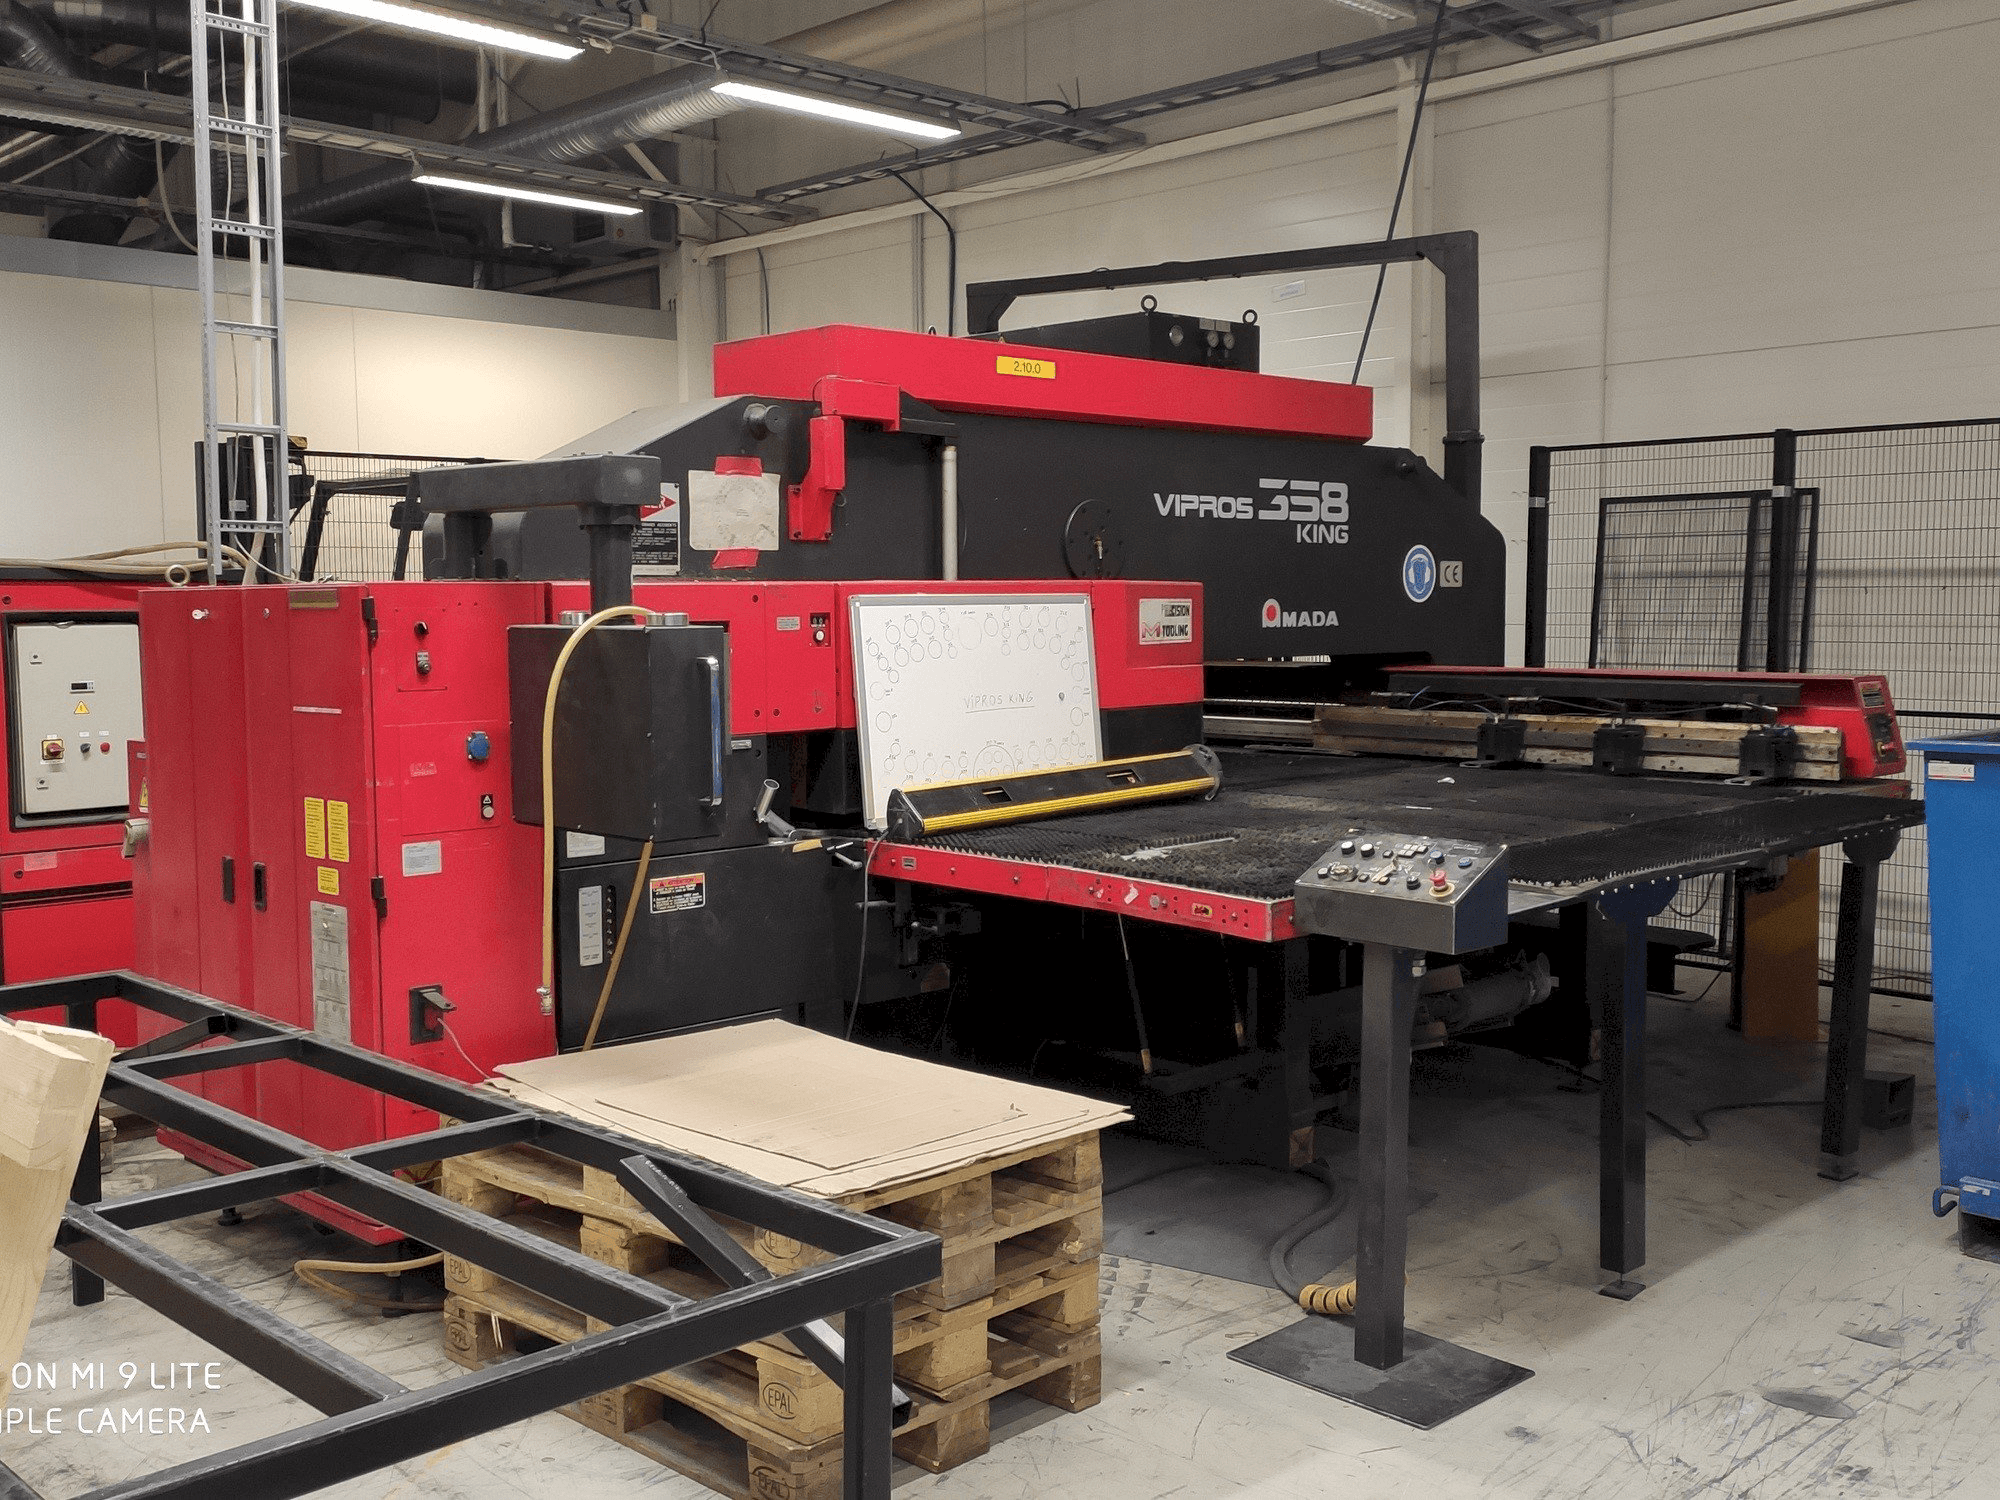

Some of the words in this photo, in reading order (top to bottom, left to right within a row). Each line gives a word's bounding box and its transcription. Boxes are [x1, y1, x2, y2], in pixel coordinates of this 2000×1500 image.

[1013, 360, 1042, 375] 2.10.0
[1154, 492, 1254, 520] VIPROS
[1258, 478, 1349, 523] 358
[1296, 523, 1349, 544] KING
[1444, 565, 1460, 584] CE
[1261, 598, 1339, 628] AMADA
[1162, 624, 1189, 638] TOOLING
[767, 1387, 795, 1415] EPAL
